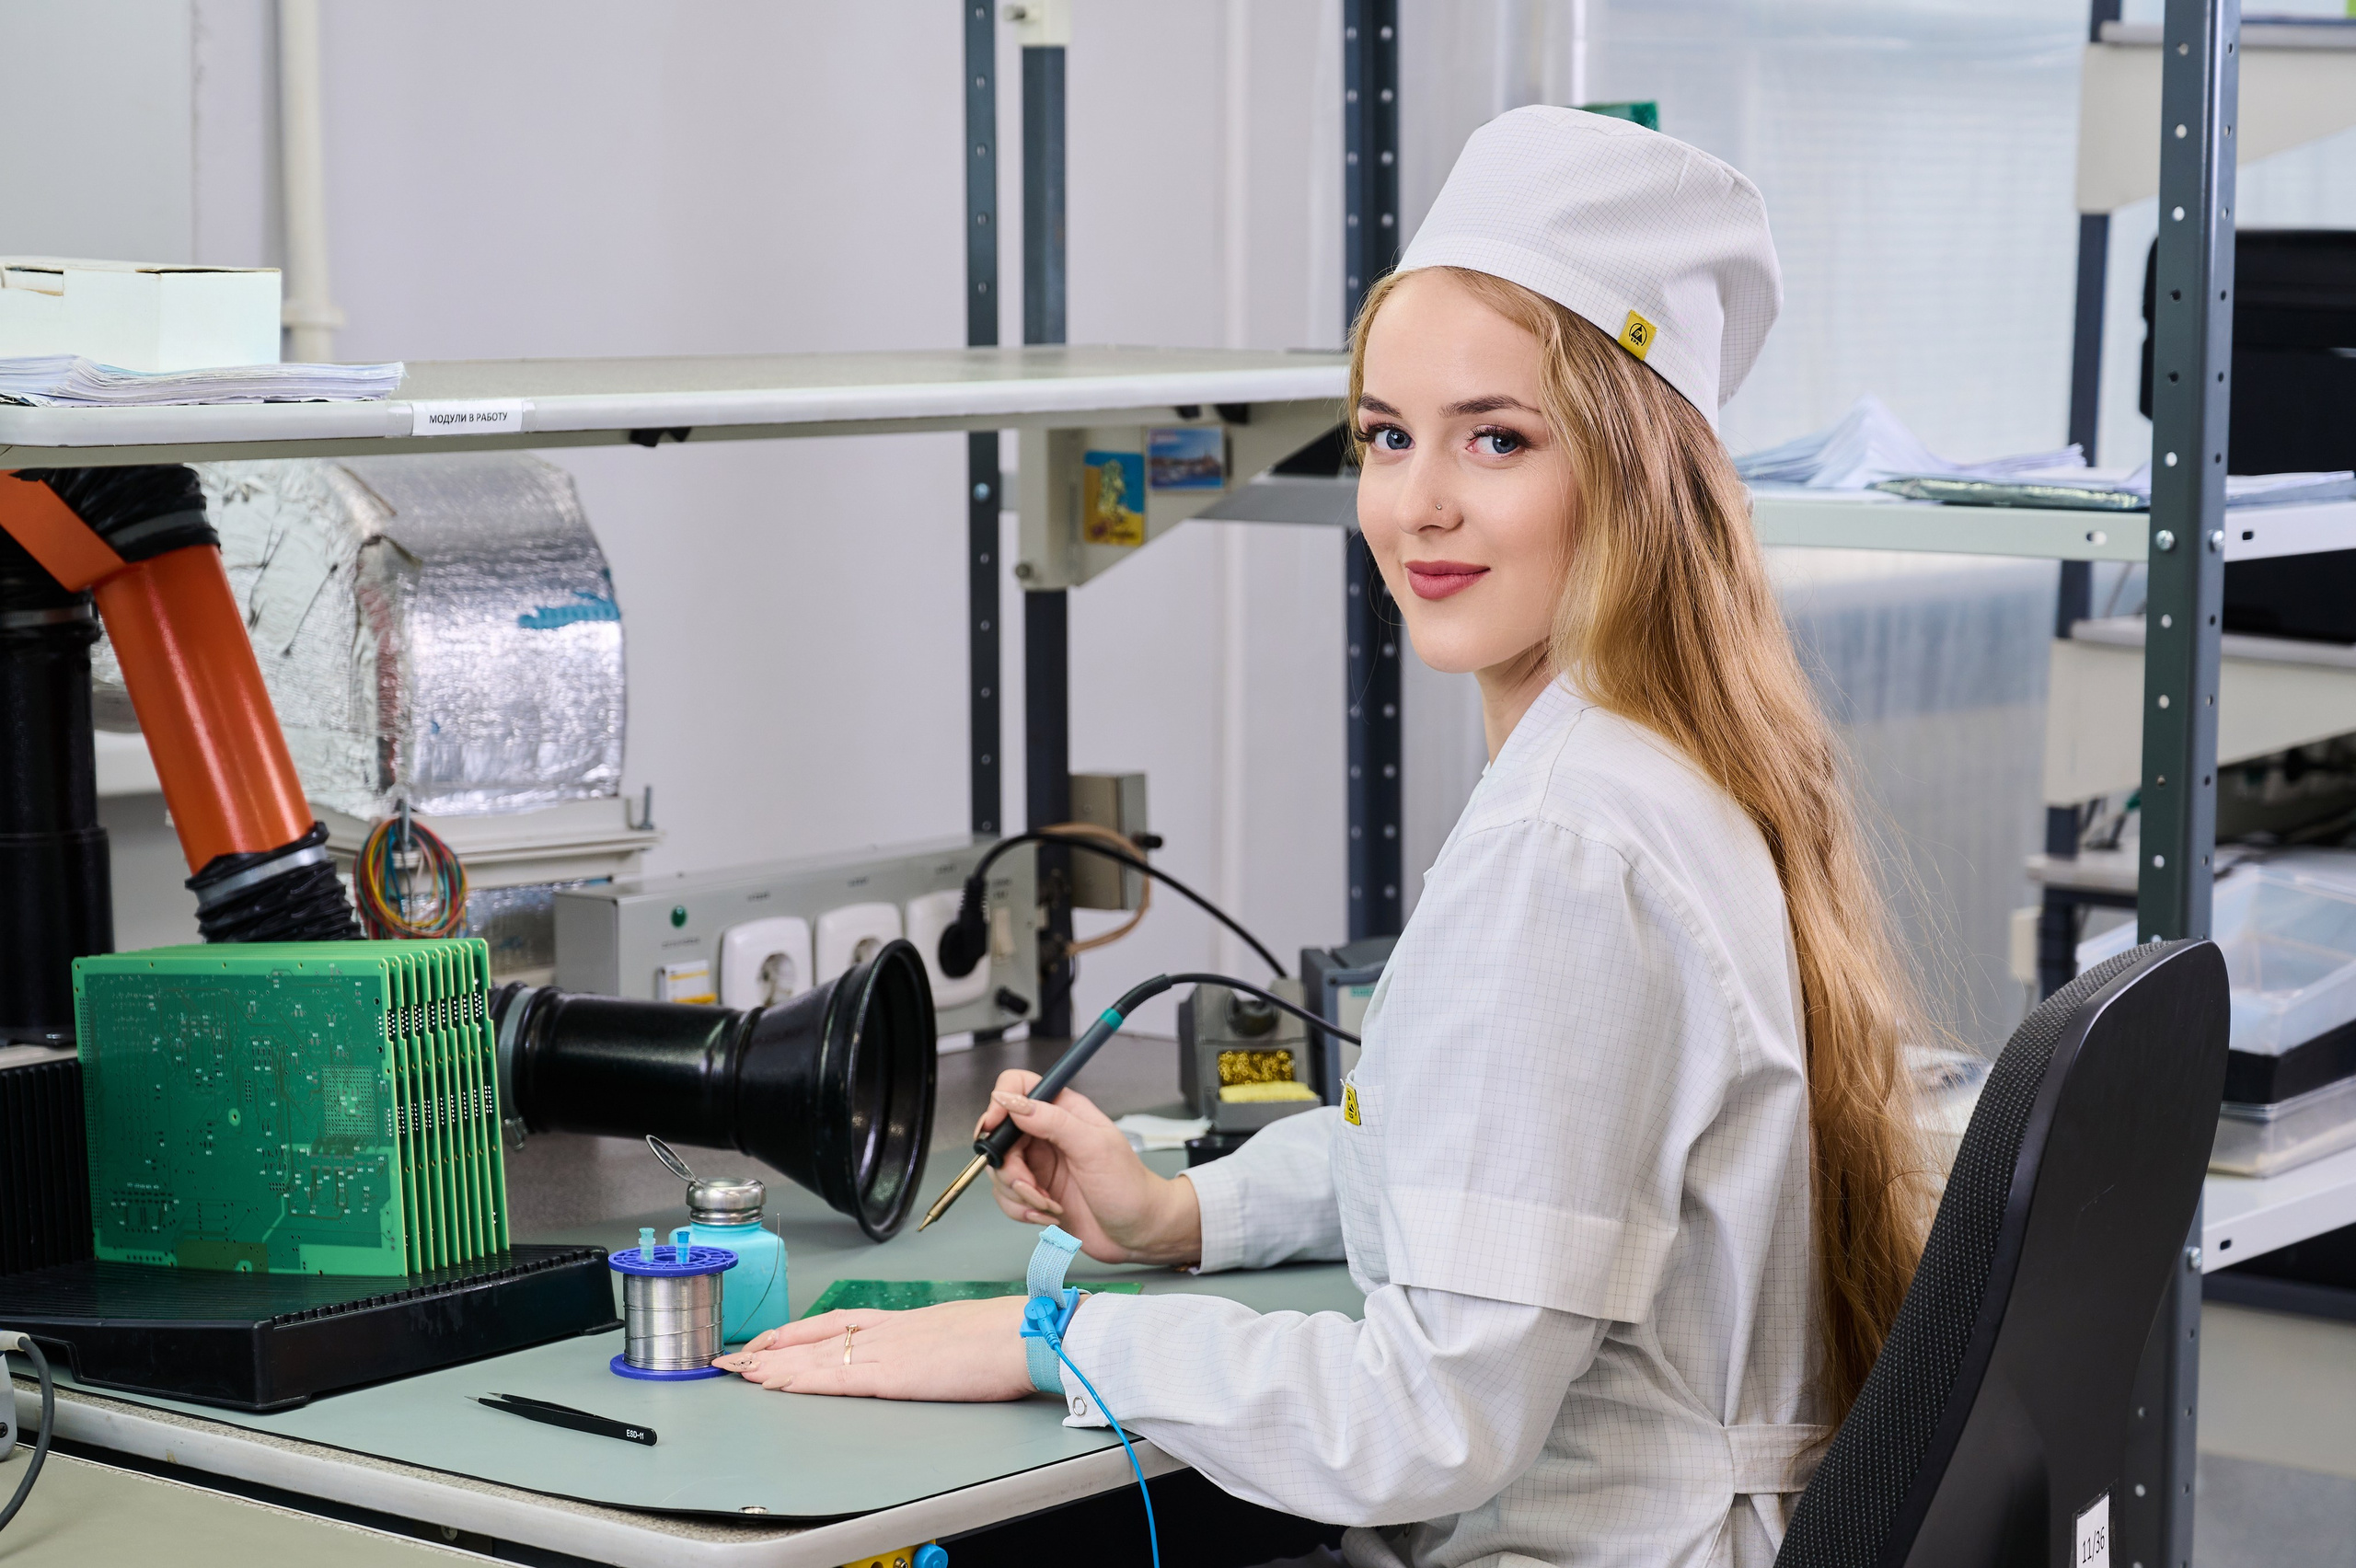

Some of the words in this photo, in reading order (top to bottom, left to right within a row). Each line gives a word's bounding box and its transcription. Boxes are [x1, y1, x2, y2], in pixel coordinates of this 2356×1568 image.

[429, 414, 467, 425] МОДУЛИ
[468, 413, 475, 422] В
[476, 411, 508, 422] РАБОТУ
[626, 1429, 644, 1440] ESD-11
[2082, 1526, 2106, 1564] 11/36
